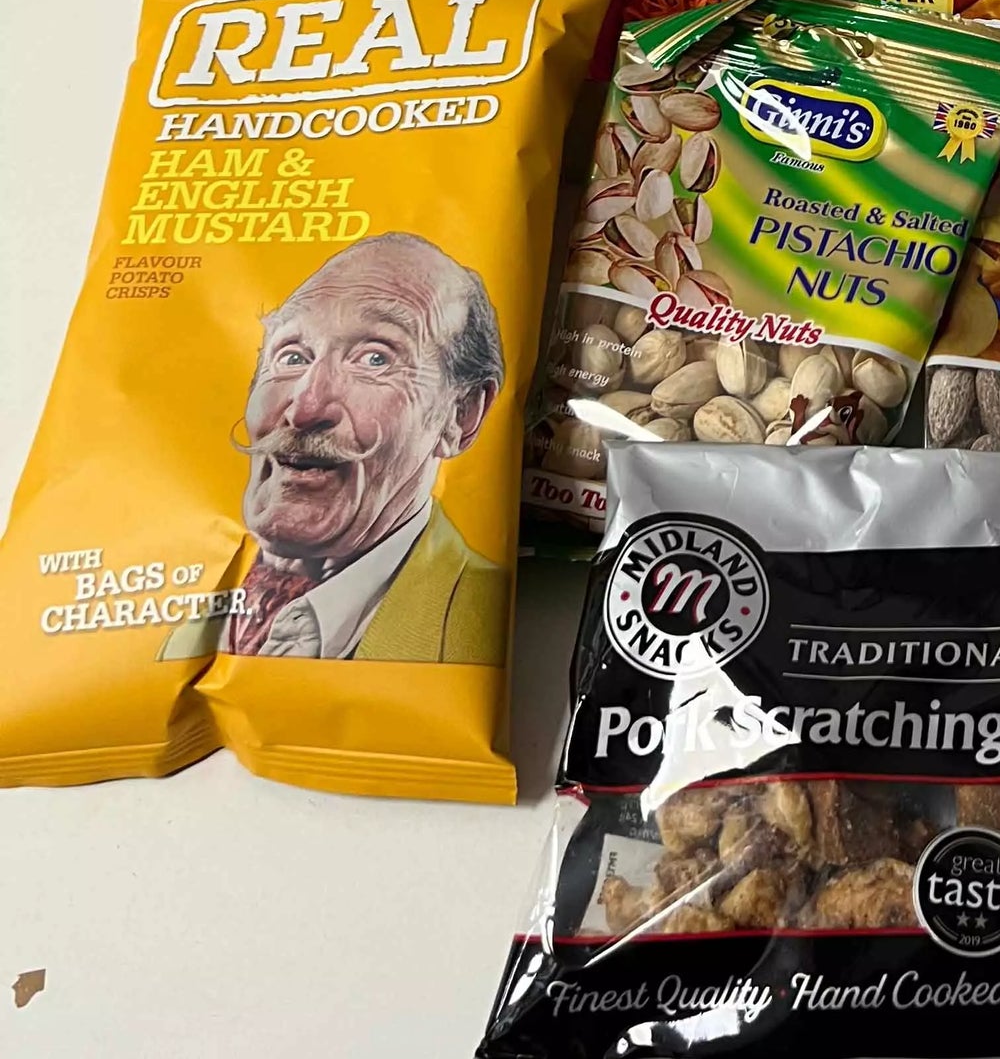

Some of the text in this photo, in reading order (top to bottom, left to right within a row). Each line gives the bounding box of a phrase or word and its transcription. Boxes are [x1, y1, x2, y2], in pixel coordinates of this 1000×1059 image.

[155, 94, 500, 143] HANDCOOKED
[751, 89, 871, 145] Ginni's
[142, 146, 316, 180] HAM &
[770, 150, 825, 173] Famous
[131, 178, 355, 212] ENGLISH
[762, 187, 969, 238] Roasted & Salted
[120, 210, 372, 246] MUSTARD
[113, 256, 203, 270] FLAVOUR
[748, 215, 959, 277] PISTACHIO
[105, 286, 171, 300] CRISPS
[109, 271, 185, 285] POTATO
[786, 266, 890, 307] NUTS
[646, 292, 823, 348] Quality Nuts
[582, 331, 594, 344] in
[597, 339, 643, 359] protein
[568, 367, 610, 387] energy
[531, 476, 574, 505] Too
[39, 548, 104, 574] WITH
[620, 529, 759, 597] MIDLAND
[75, 562, 204, 603] BAGS OF
[40, 588, 253, 635] CHARACTER.
[958, 934, 981, 946] 2019
[547, 979, 650, 1019] Finest
[656, 974, 774, 1024] Quality
[790, 972, 887, 1012] Hand
